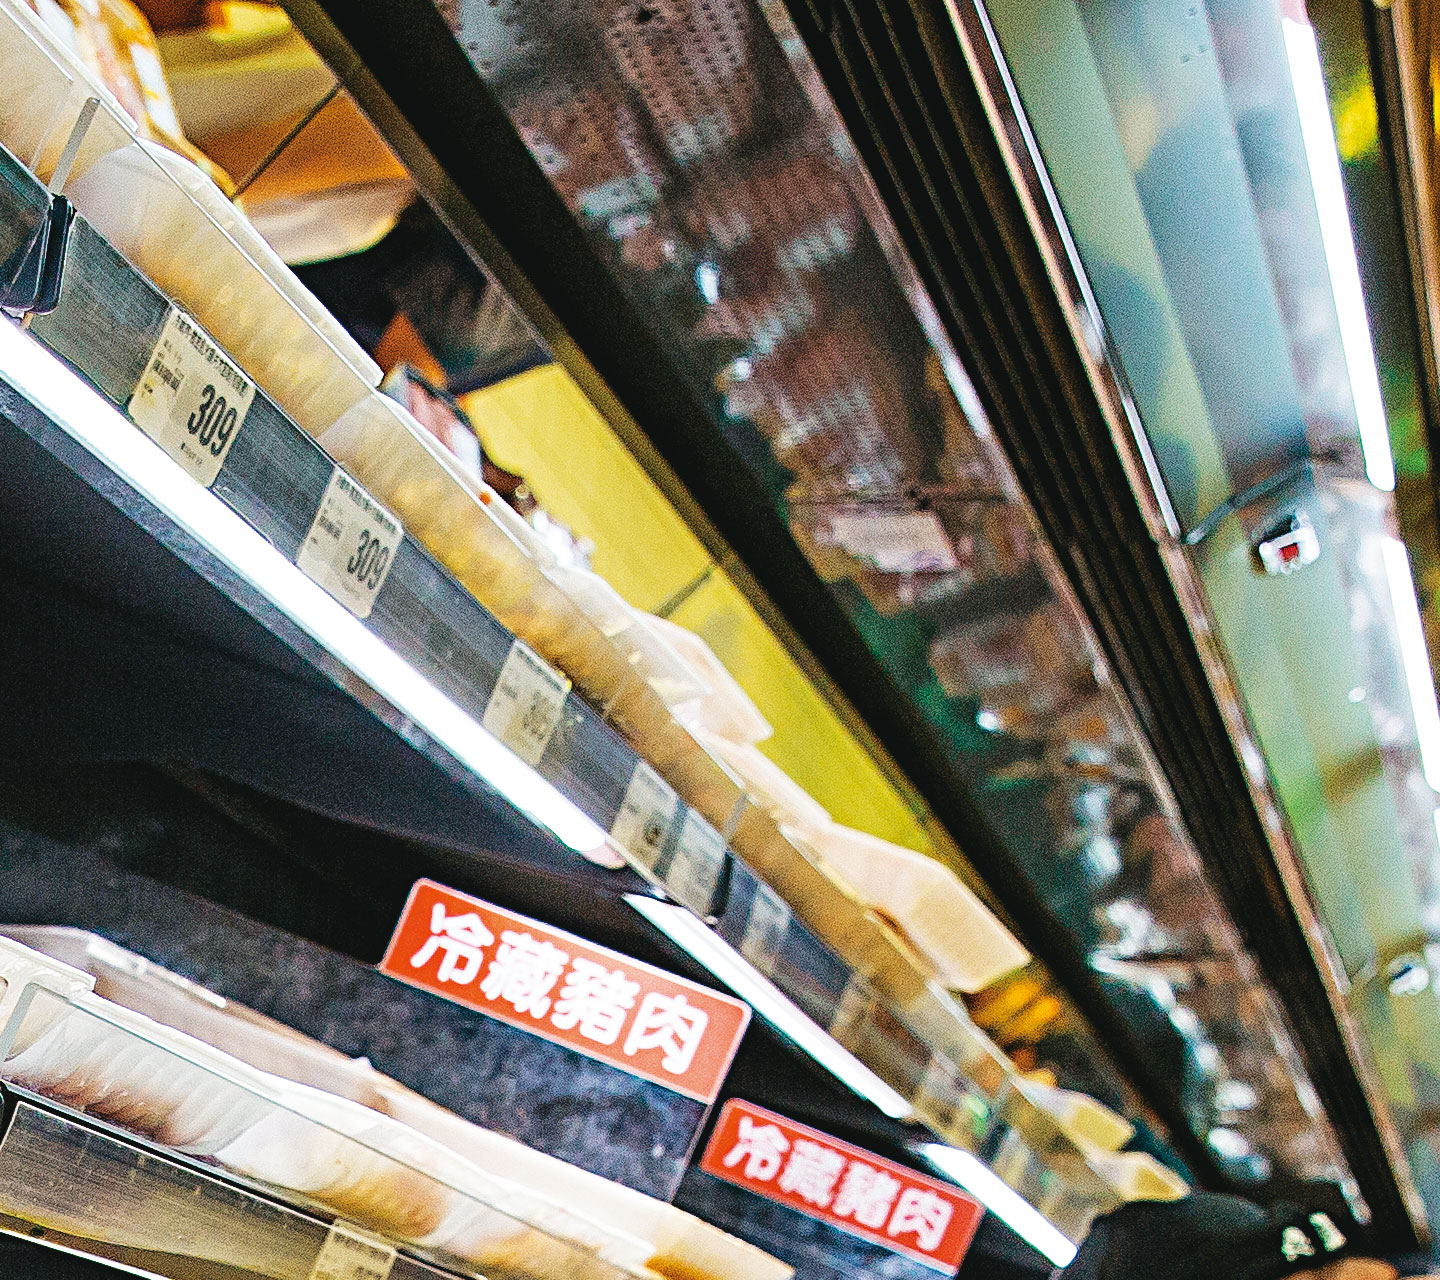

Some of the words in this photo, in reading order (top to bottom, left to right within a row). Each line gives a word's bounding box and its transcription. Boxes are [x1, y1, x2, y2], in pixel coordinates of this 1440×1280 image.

[188, 384, 237, 456] 309
[347, 529, 390, 590] 309
[411, 903, 709, 1075] 冷藏豬肉
[723, 1116, 954, 1251] 冷藏豬肉
